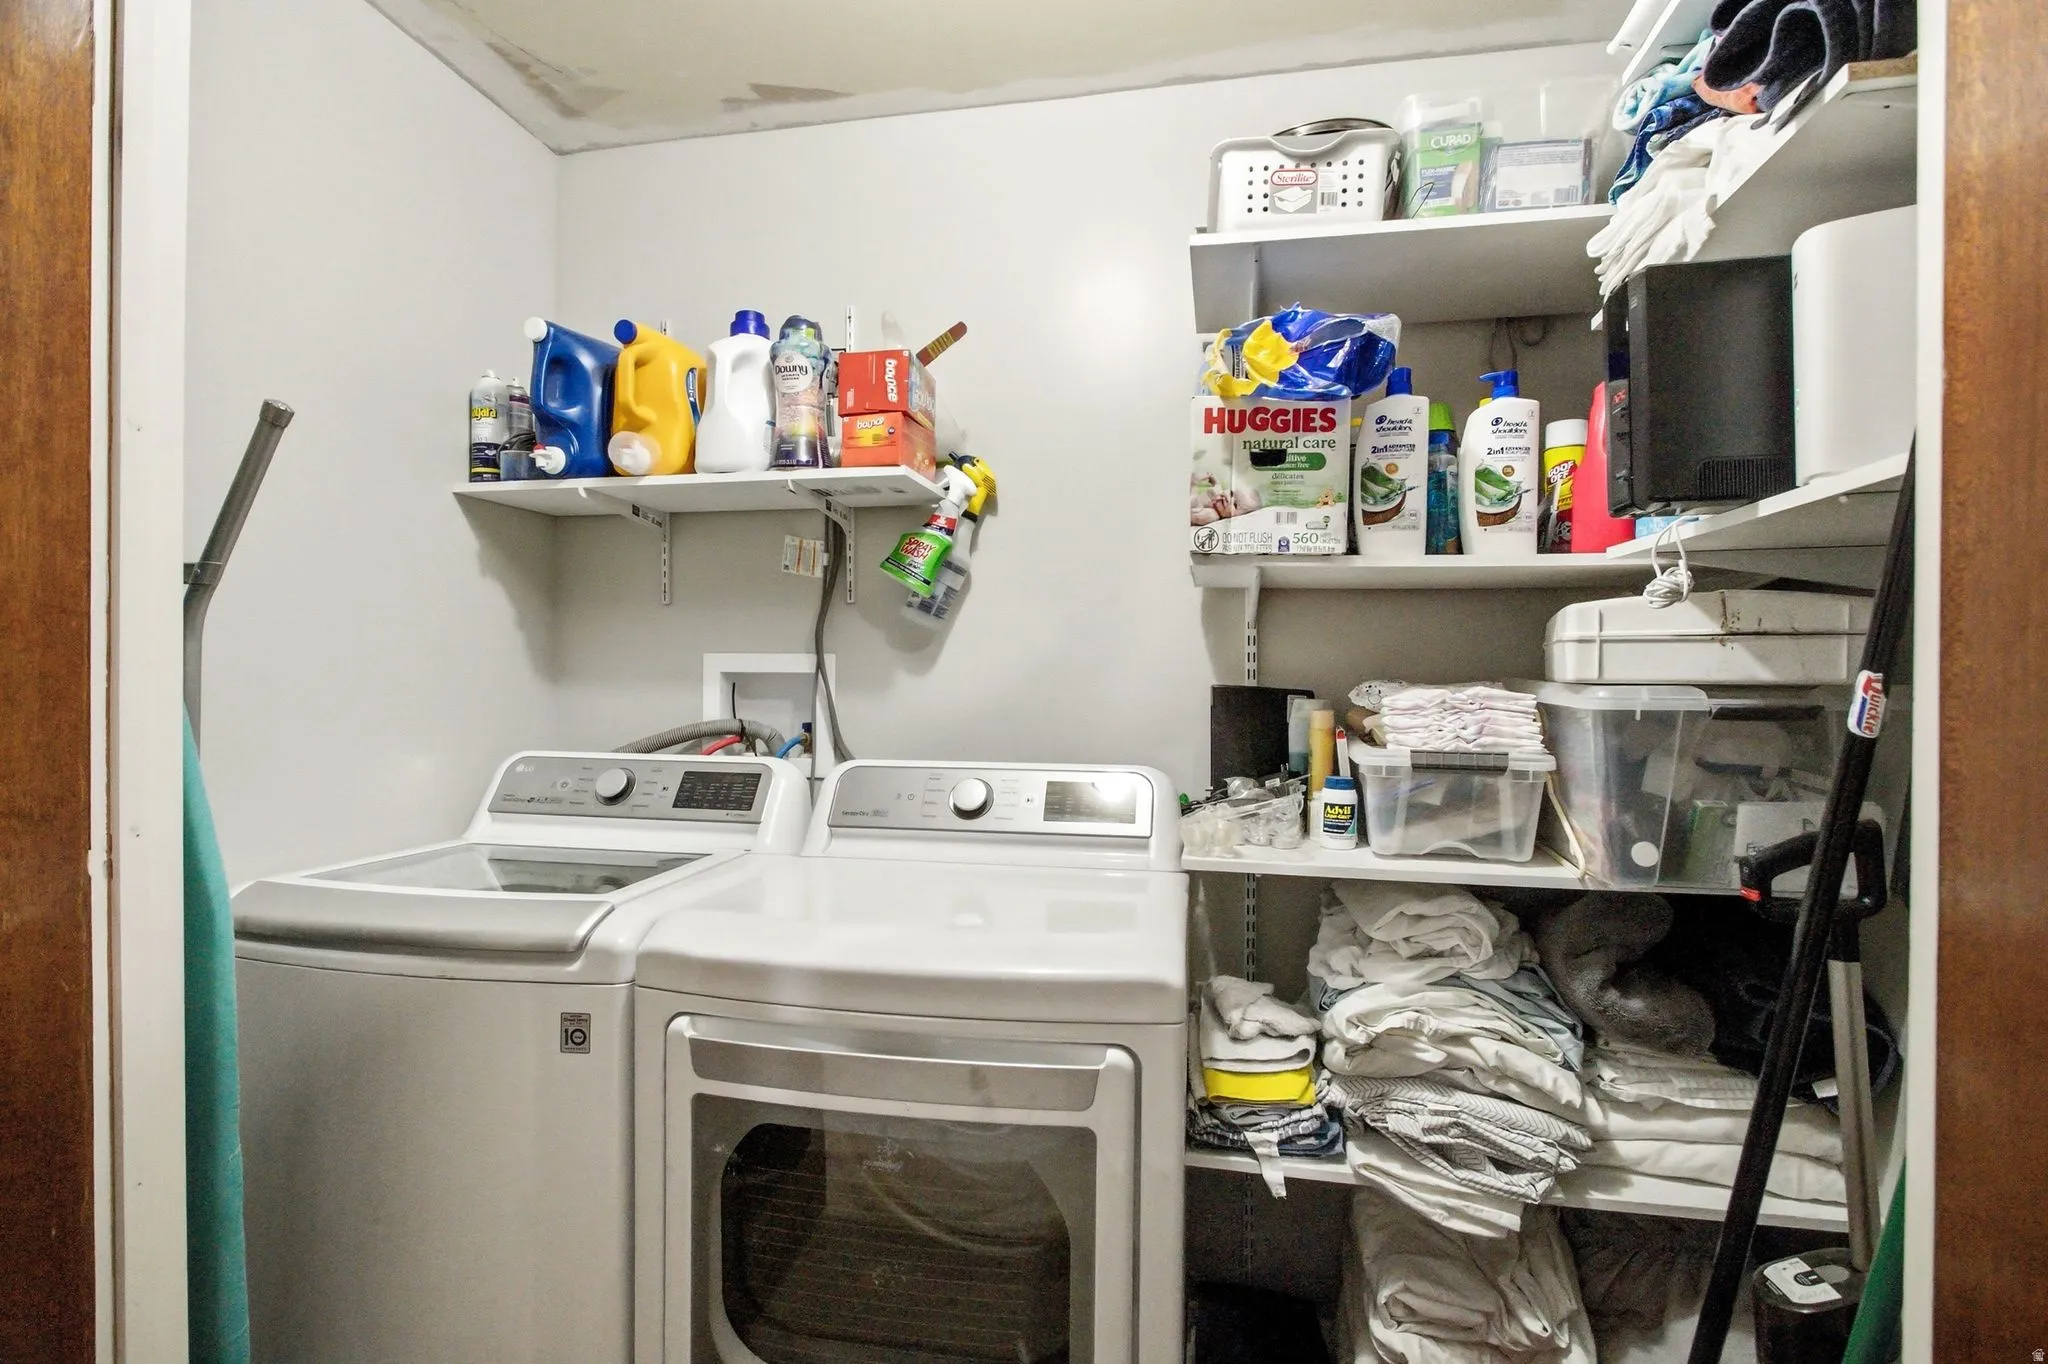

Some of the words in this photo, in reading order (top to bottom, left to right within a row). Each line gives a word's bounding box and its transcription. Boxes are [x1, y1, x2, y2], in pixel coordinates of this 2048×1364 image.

[1431, 134, 1472, 149] CURAD
[775, 365, 808, 376] Downy
[885, 358, 898, 403] bounce
[857, 416, 885, 429] bounce
[1203, 406, 1337, 433] HUGGIES
[1243, 436, 1299, 449] natural
[1303, 438, 1337, 449] care
[1371, 444, 1388, 454] 2in1
[1487, 446, 1504, 455] 2in1
[1222, 533, 1232, 543] DO
[1233, 533, 1247, 543] NOT
[1249, 532, 1273, 543] FLUSH
[1293, 532, 1319, 544] 560
[905, 536, 937, 553] SPRAY
[900, 544, 929, 560] WASH
[1325, 805, 1352, 817] Advil
[564, 1028, 587, 1047] 10
